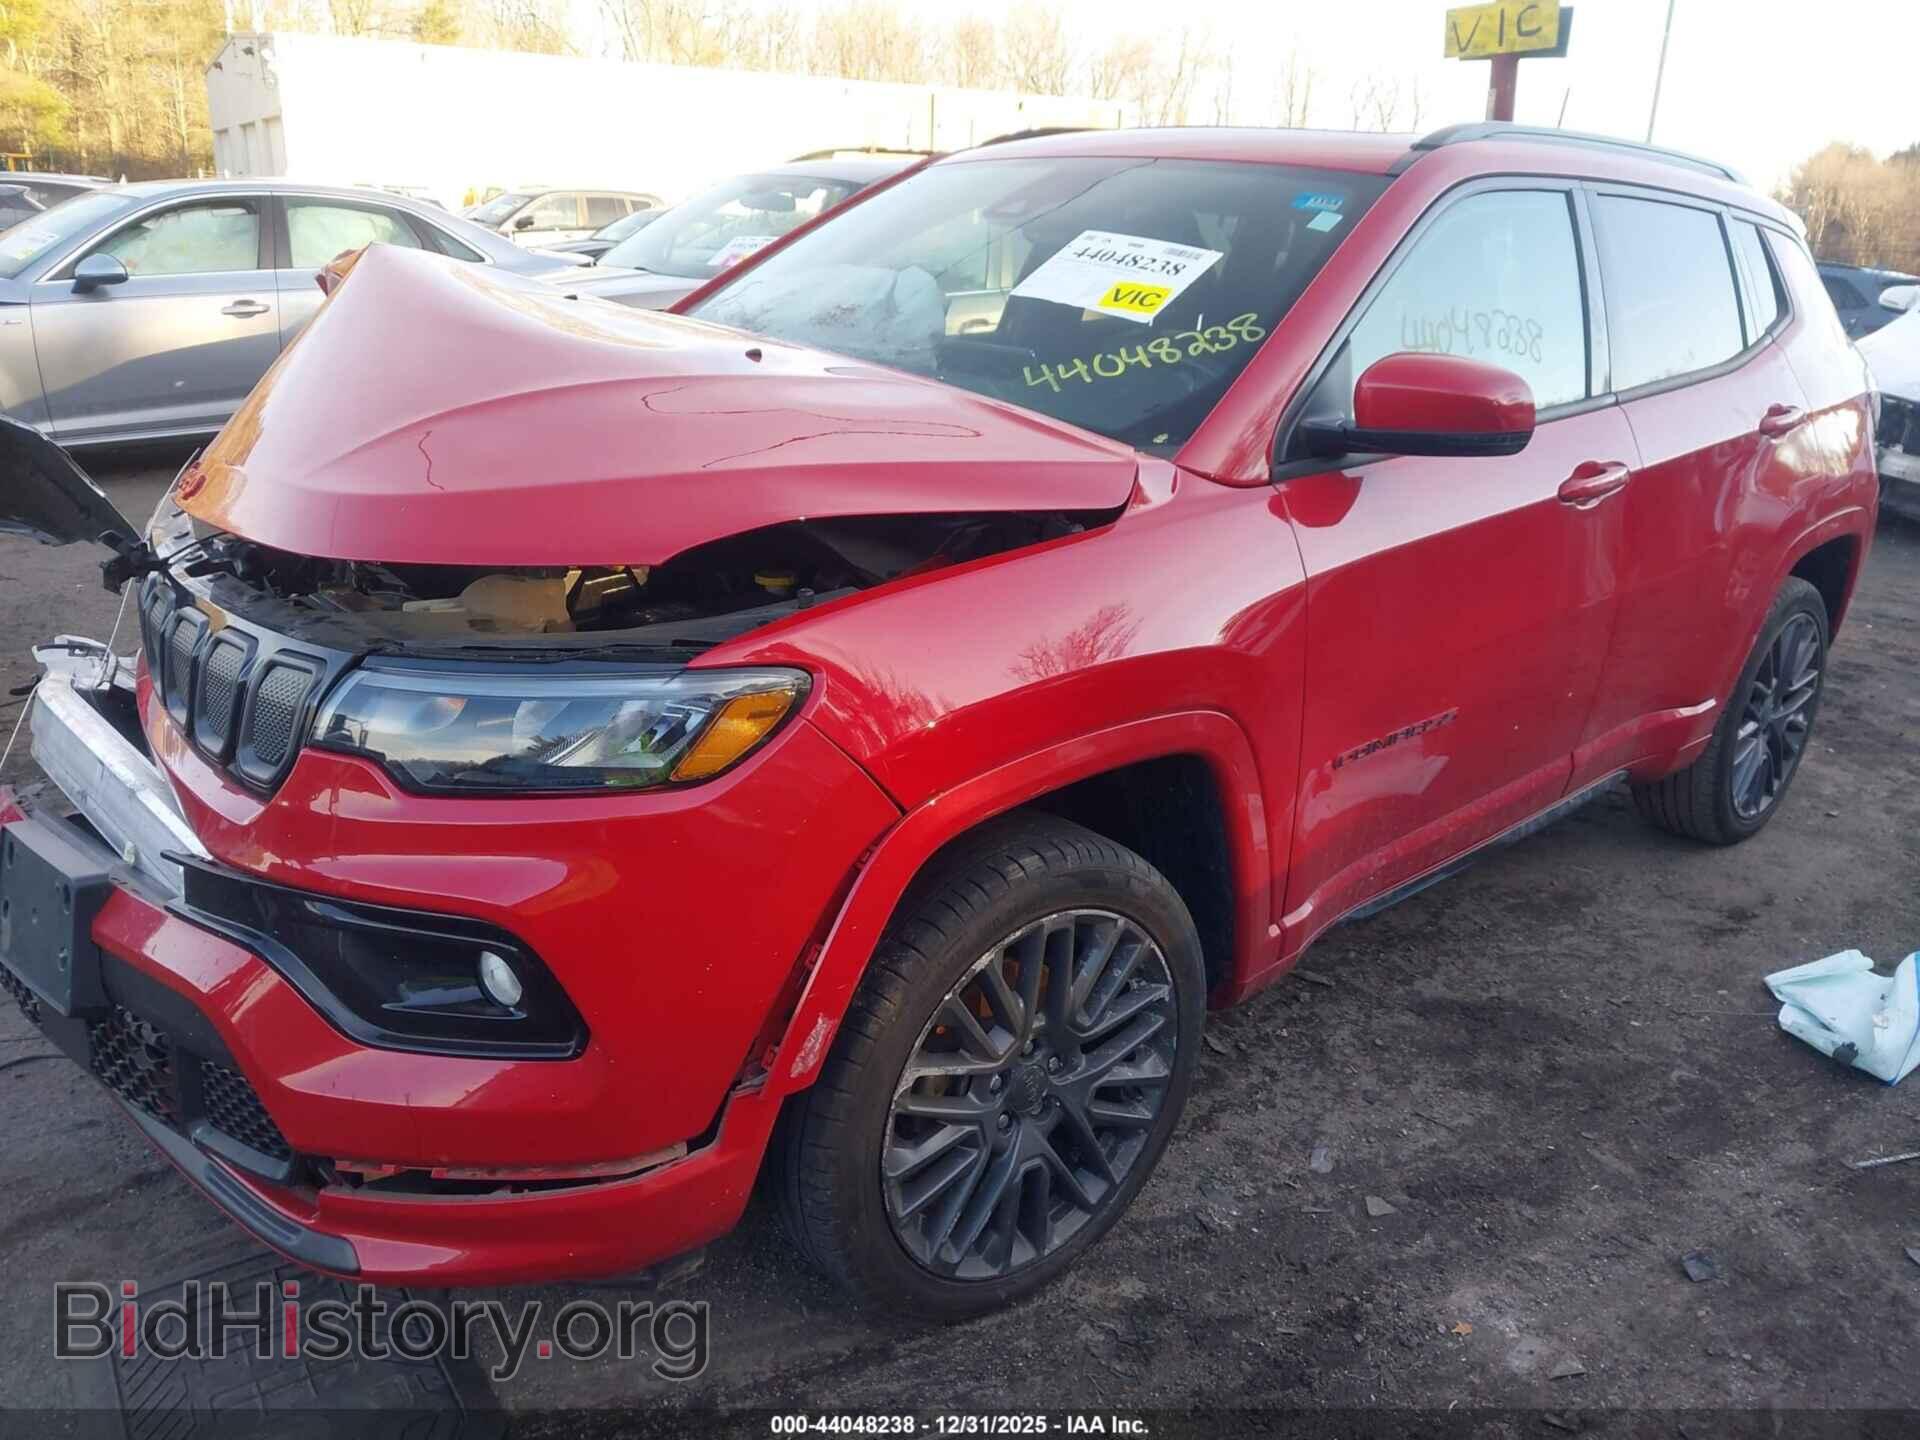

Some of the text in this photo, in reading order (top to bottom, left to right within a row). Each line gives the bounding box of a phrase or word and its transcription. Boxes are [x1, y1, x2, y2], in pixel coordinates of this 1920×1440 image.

[1452, 4, 1543, 53] VIC
[1073, 246, 1187, 276] 44048238
[1112, 287, 1163, 308] VIC
[1022, 312, 1266, 393] 44048238
